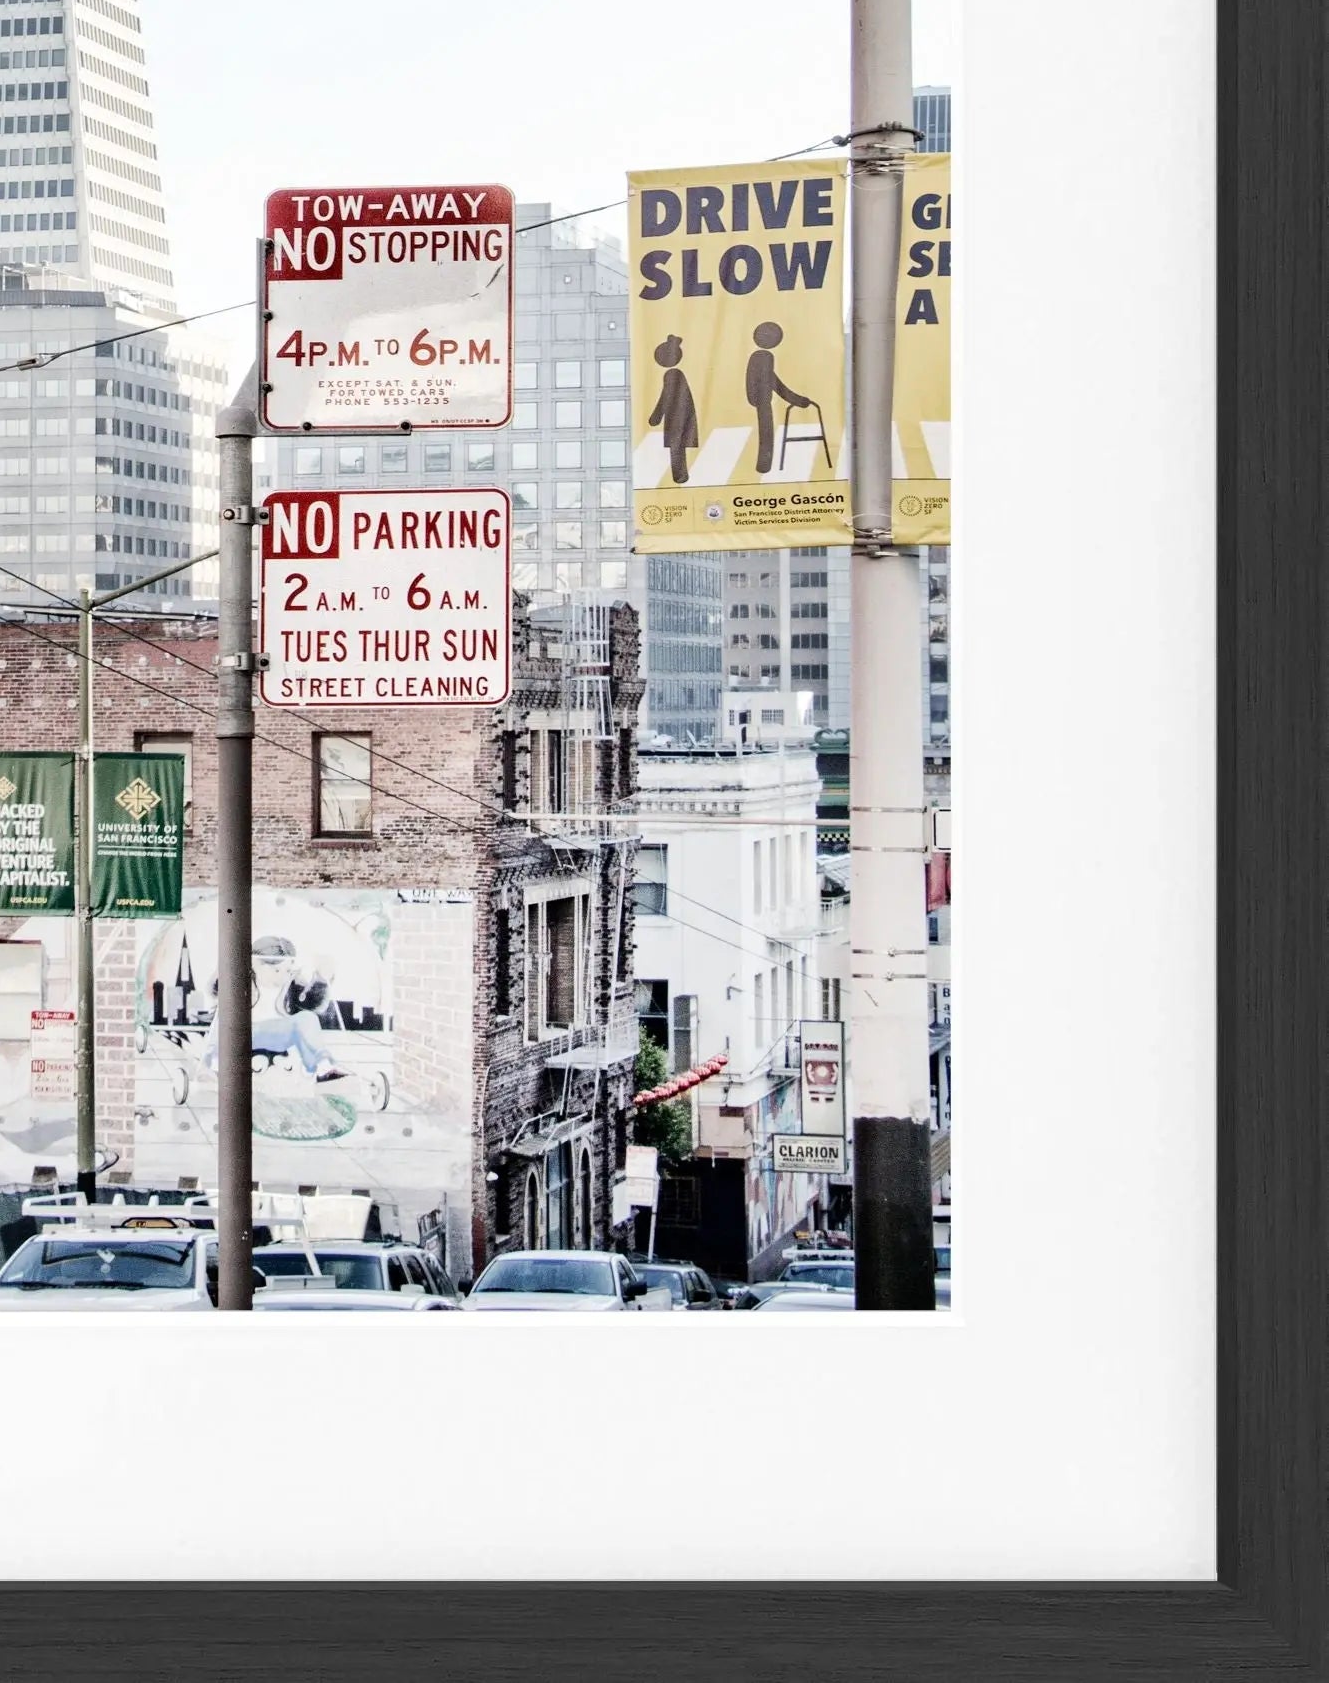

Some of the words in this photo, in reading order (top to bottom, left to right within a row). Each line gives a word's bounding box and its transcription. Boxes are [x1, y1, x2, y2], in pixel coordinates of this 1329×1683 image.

[291, 192, 487, 222] TOW-AWAY
[641, 177, 834, 238] DRIVE
[911, 193, 951, 230] G
[272, 226, 336, 272] NO
[348, 228, 503, 264] STOPPING
[638, 240, 833, 301] SLOW
[904, 289, 939, 325] A
[276, 329, 369, 367] 4P.M.
[375, 339, 400, 356] TO
[409, 328, 501, 366] 6P.M.
[318, 379, 370, 388] EXCEPT
[375, 379, 404, 388] SAT.
[411, 379, 420, 387] &
[426, 378, 457, 387] SUN.
[329, 389, 355, 397] FOR
[361, 388, 404, 397] TOWED
[410, 388, 445, 396] CARS
[325, 398, 371, 406] PHONE
[383, 397, 450, 406] 553-1235
[733, 496, 787, 509] George
[791, 492, 845, 506] Gascón
[733, 510, 747, 518] San
[749, 509, 782, 518] Francisco
[784, 508, 811, 516] District
[759, 517, 789, 526] Services
[791, 516, 821, 525] Division
[272, 501, 333, 554] NO
[353, 509, 501, 550] PARKING
[372, 586, 390, 600] TO
[281, 630, 348, 663] TUES
[359, 629, 430, 662] THUR
[442, 629, 498, 662] SUN
[281, 677, 366, 698] STREET
[376, 676, 489, 697] CLEANING
[14, 820, 40, 835] THE
[97, 823, 161, 834] UNIVERSITY
[164, 825, 177, 834] OF
[97, 834, 119, 843] SAN
[121, 834, 178, 844] FRANCISCO
[779, 1145, 839, 1159] CLARION
